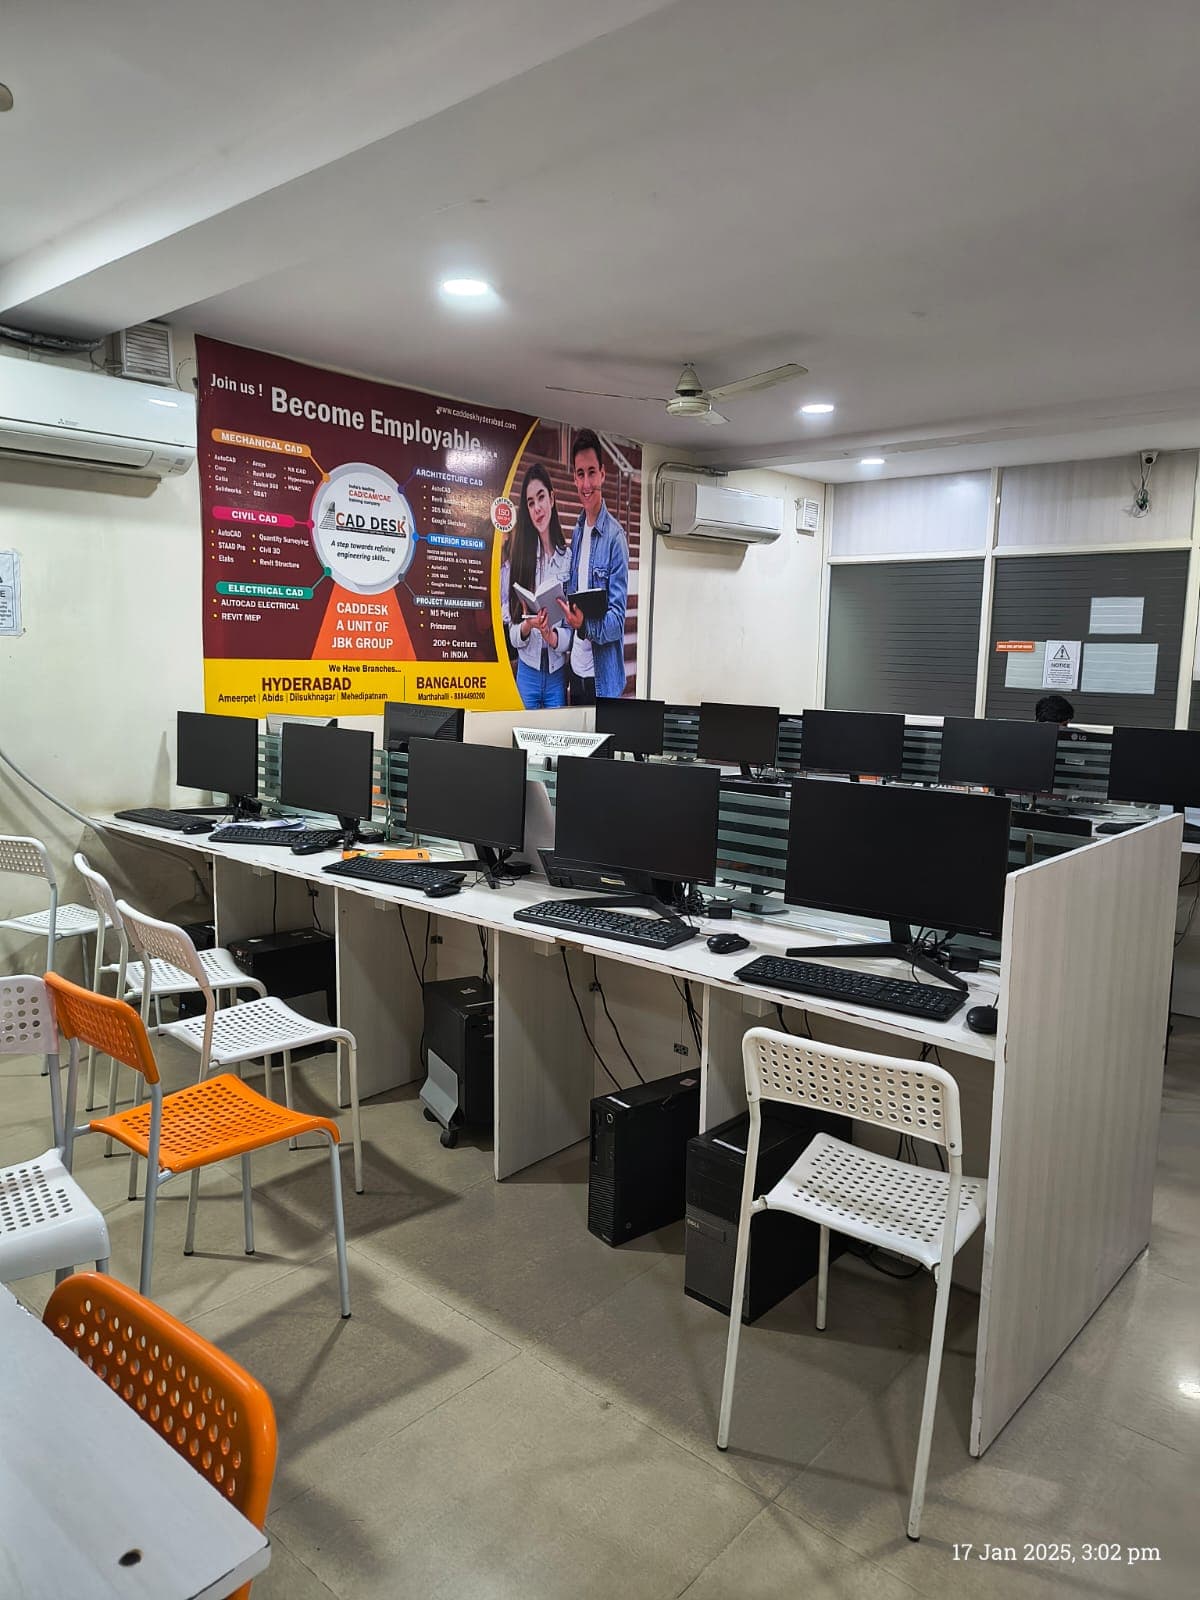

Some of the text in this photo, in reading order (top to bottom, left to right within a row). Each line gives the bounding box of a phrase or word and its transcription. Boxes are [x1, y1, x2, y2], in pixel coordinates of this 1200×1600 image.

[210, 373, 481, 450] Join us ! Become Employable
[221, 432, 303, 454] MECHANICAL CAD
[214, 454, 236, 463] AutoCAD
[416, 468, 483, 486] ARCHITECTURE CAD
[215, 485, 241, 494] Solidworks
[349, 490, 391, 502] CAD/CAM/CAE
[232, 510, 278, 523] CIVIL CAD
[336, 512, 406, 533] CAD DESK
[218, 528, 241, 538] AutoCAD
[259, 534, 309, 546] Quantity Surveying
[430, 536, 460, 545] INTERIOR
[218, 542, 236, 550] STAAD
[259, 546, 271, 554] Civil
[374, 544, 395, 554] refining
[219, 555, 234, 563] Etabs
[337, 551, 370, 561] engineering
[260, 558, 299, 568] Revit Structure
[228, 584, 303, 597] ELECTRICAL CAD
[221, 599, 299, 610] AUTOCAD ELECTRICAL
[416, 597, 482, 607] PROJECT MANAGEMENT
[336, 602, 389, 616] CADDESK
[440, 610, 459, 618] Project
[244, 614, 261, 622] MEP
[336, 620, 389, 632] A UNIT OF
[430, 622, 456, 630] Primavera
[332, 637, 393, 649] JBK GROUP
[452, 640, 477, 648] Centers
[450, 651, 468, 659] INDIA
[329, 664, 341, 672] We
[262, 677, 352, 691] HYDERABAD
[416, 677, 487, 689] BANGALORE
[218, 693, 256, 703] Ameerpet
[262, 692, 284, 701] Abids
